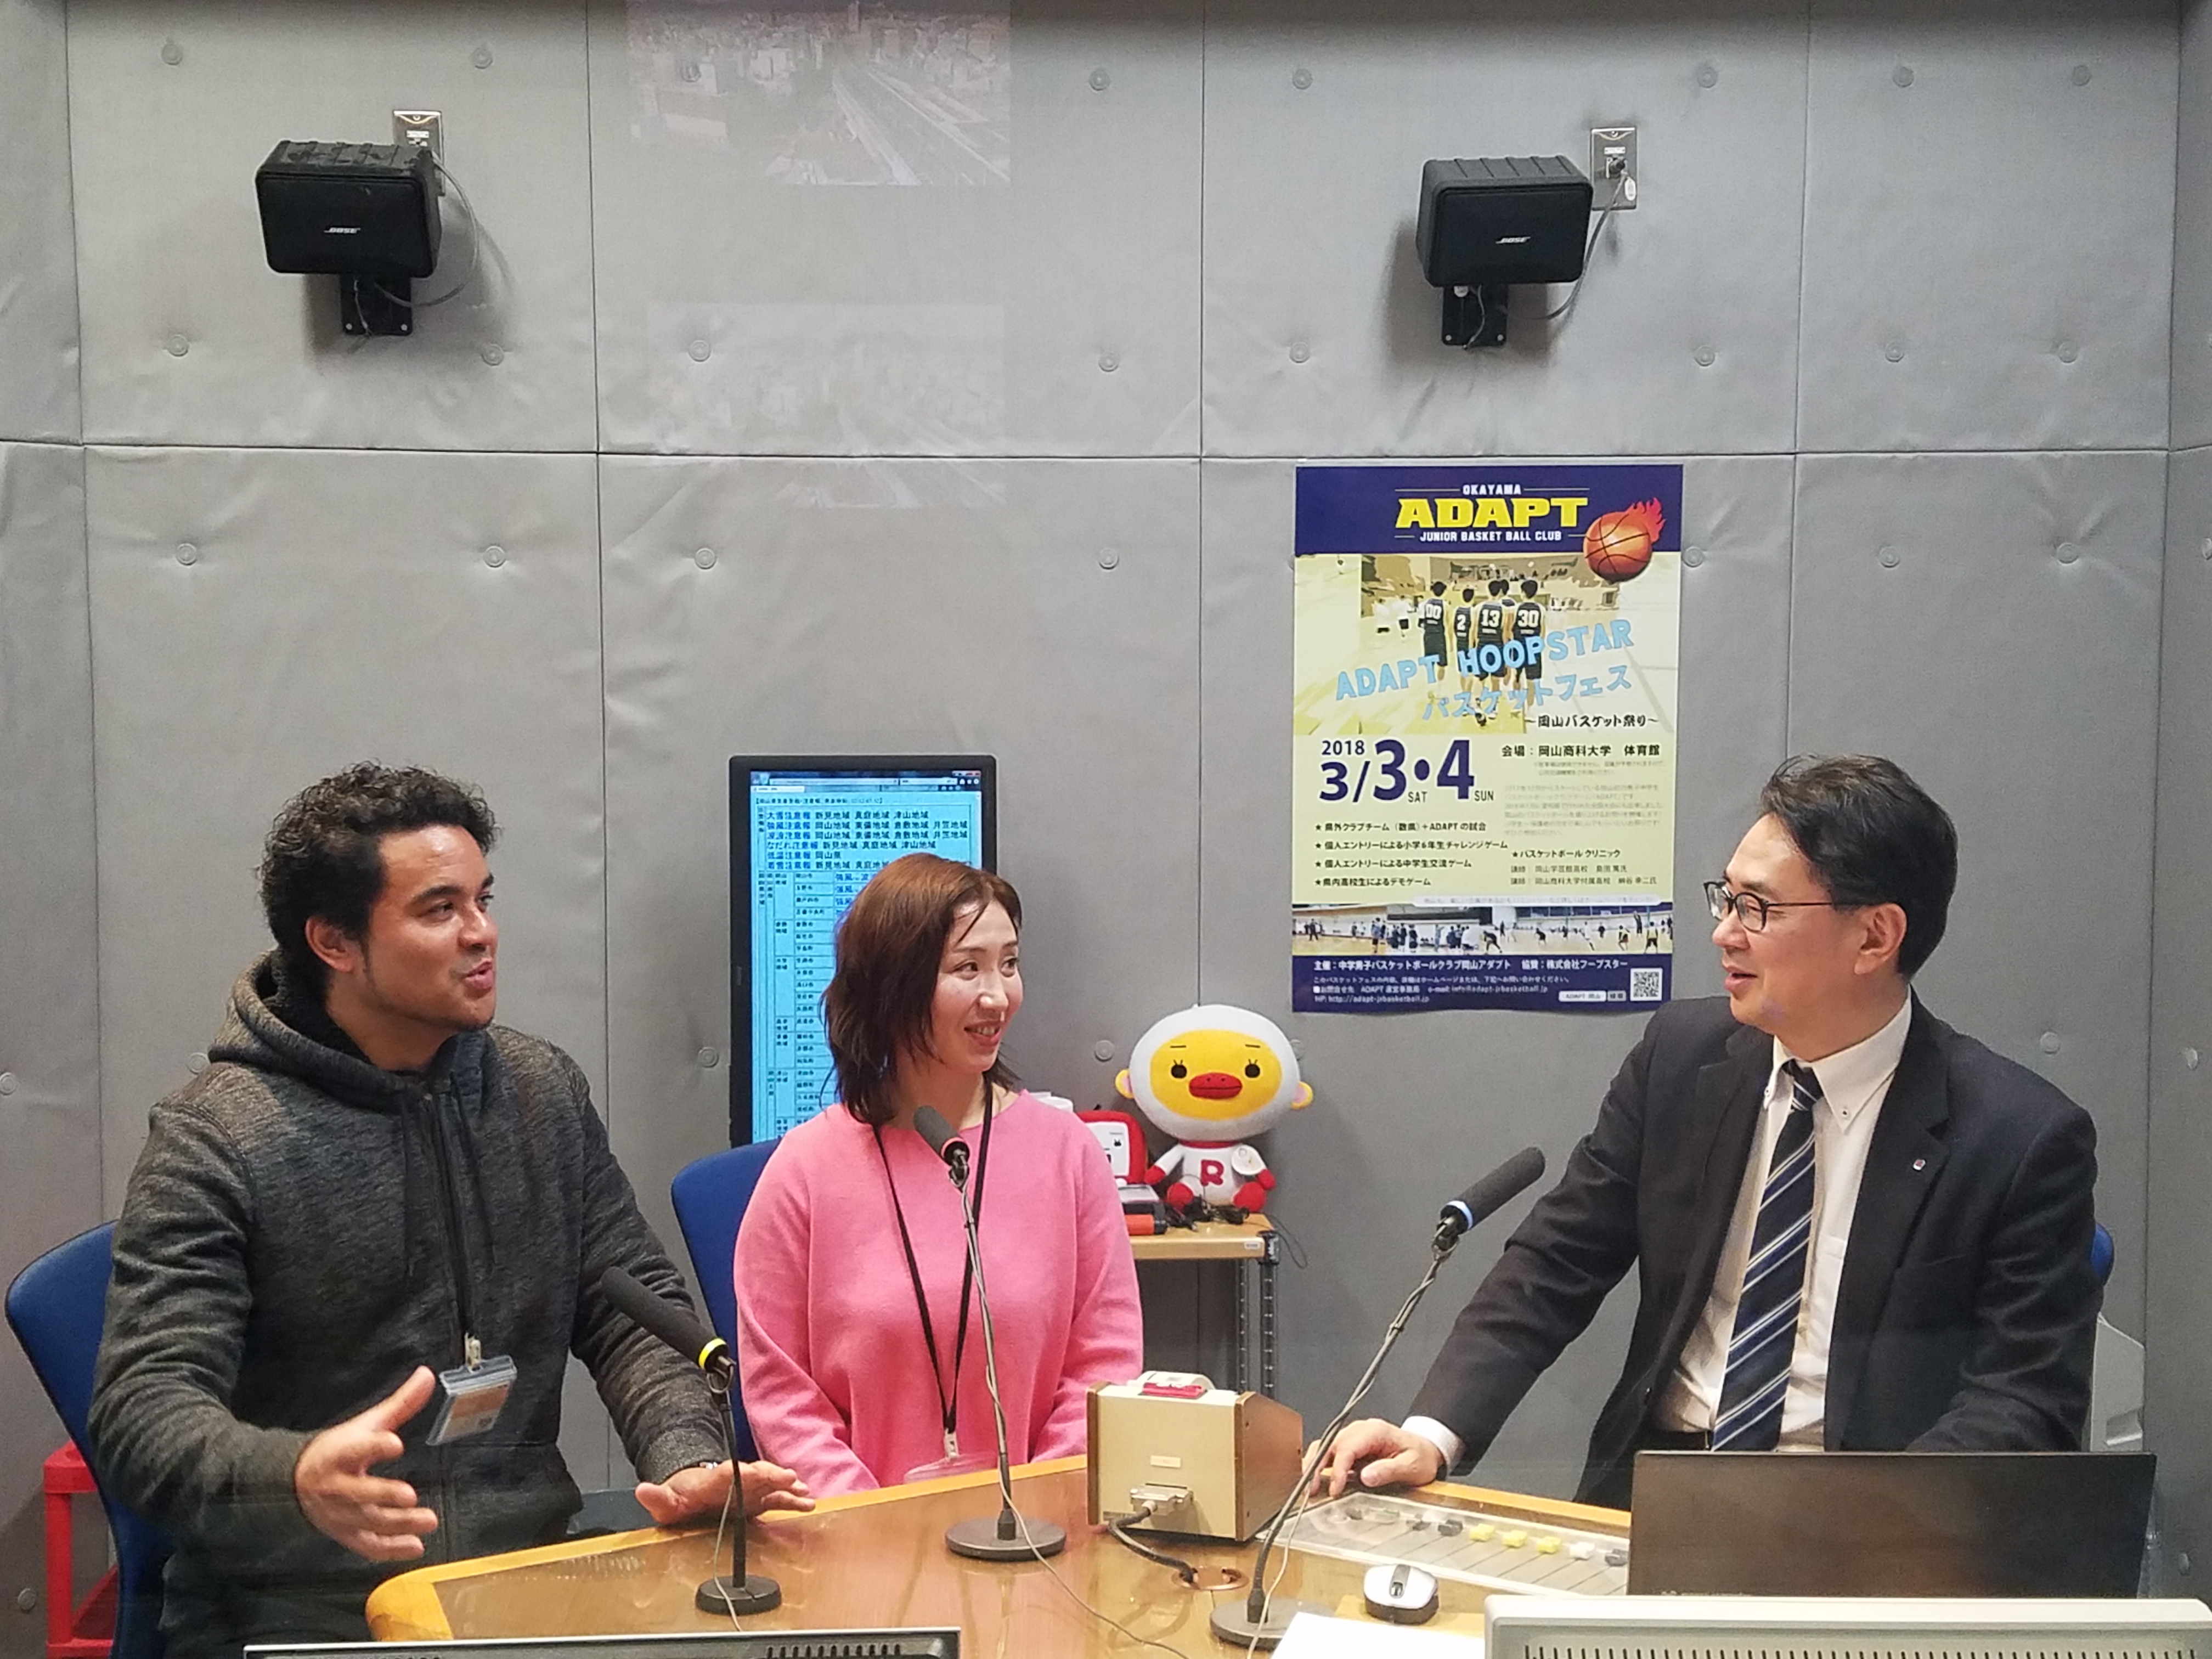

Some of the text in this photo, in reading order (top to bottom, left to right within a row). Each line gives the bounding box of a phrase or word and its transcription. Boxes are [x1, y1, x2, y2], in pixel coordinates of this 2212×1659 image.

[1496, 236, 1531, 245] BOSE
[1462, 484, 1522, 495] OKAYAMA
[1395, 498, 1588, 528] ADAPT
[1419, 531, 1562, 542] JUNIOR BASKET BALL CLUB
[1457, 614, 1466, 631] 2
[1481, 608, 1500, 628] 13
[1517, 609, 1539, 628] 30
[1335, 619, 1635, 700] ADAPT HOOPSTAR
[1422, 664, 1632, 720] バスケットフェス
[1321, 740, 1365, 755] 2018
[1623, 744, 1660, 756] 体育館
[1407, 791, 1428, 803] SAT
[1474, 790, 1494, 802] SUN
[1200, 1159, 1225, 1187] R
